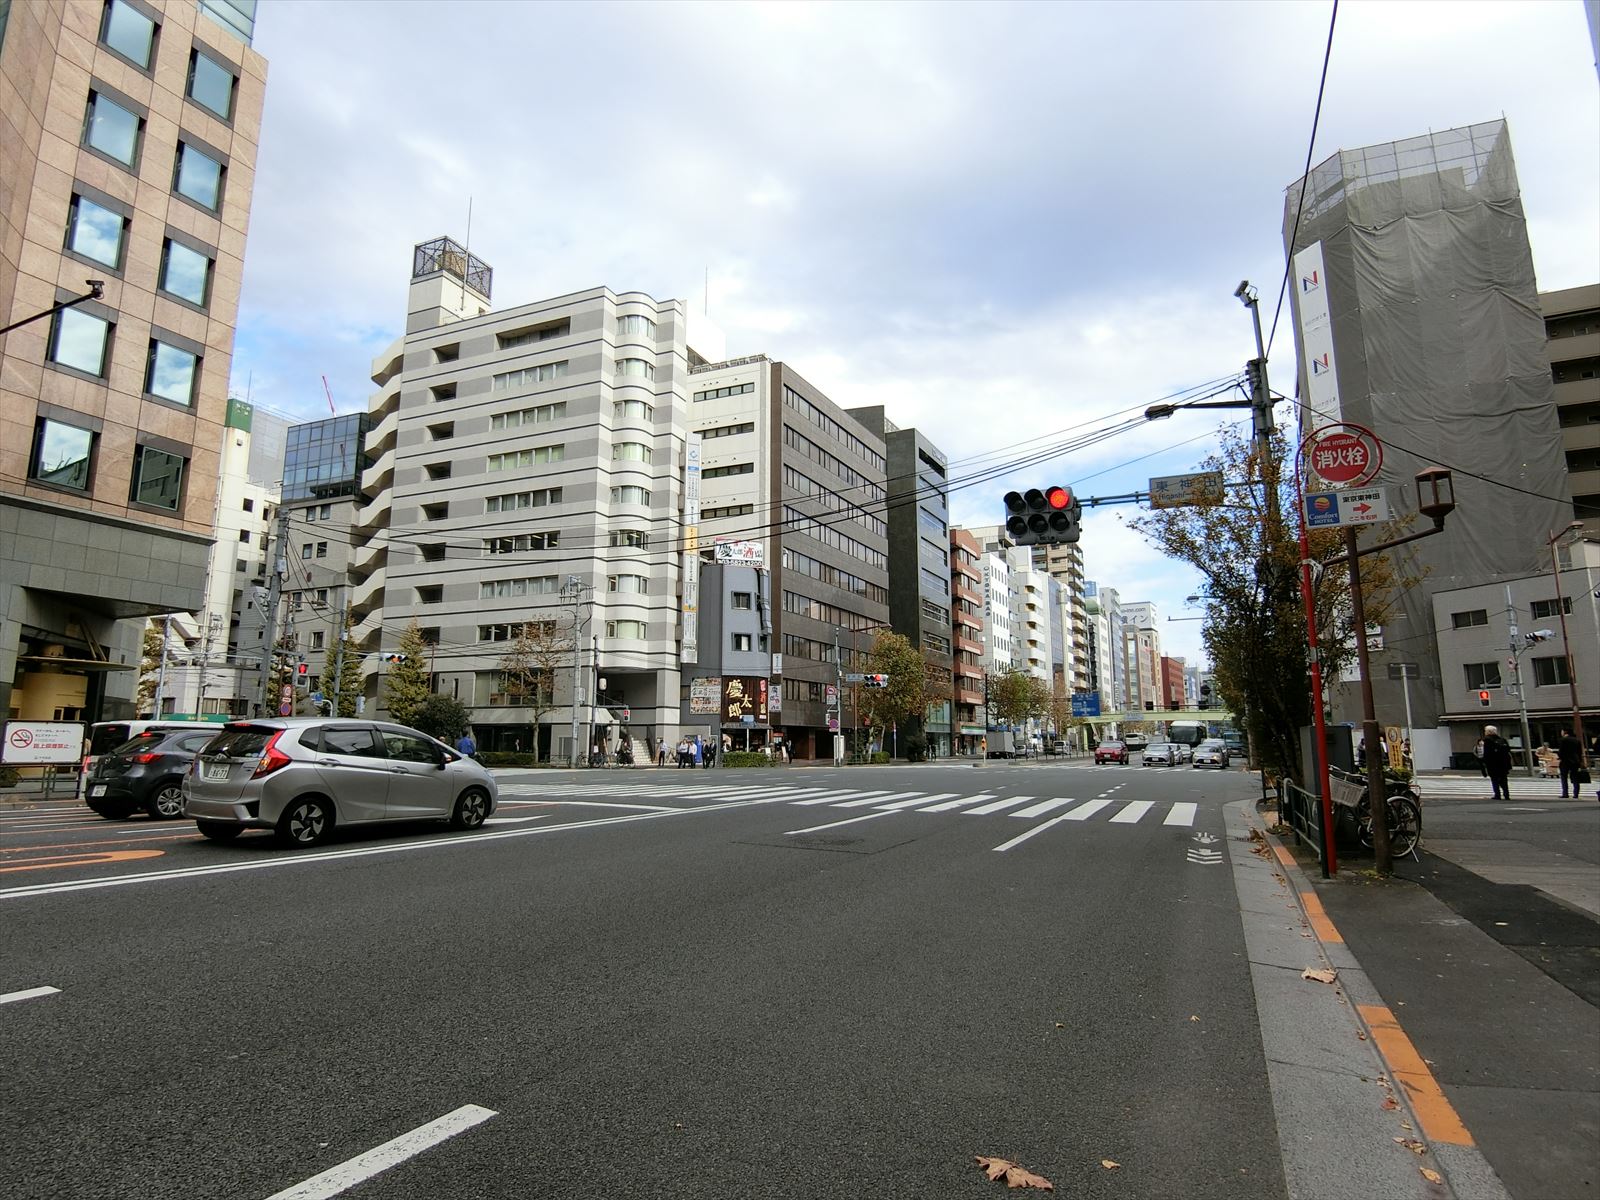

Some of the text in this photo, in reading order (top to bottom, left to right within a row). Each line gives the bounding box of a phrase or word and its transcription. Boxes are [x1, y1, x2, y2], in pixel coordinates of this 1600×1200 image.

[1332, 438, 1357, 446] HYDRANT
[1316, 447, 1365, 469] 消火栓
[1308, 512, 1338, 520] Comfort
[725, 679, 753, 718] 慶太郎
